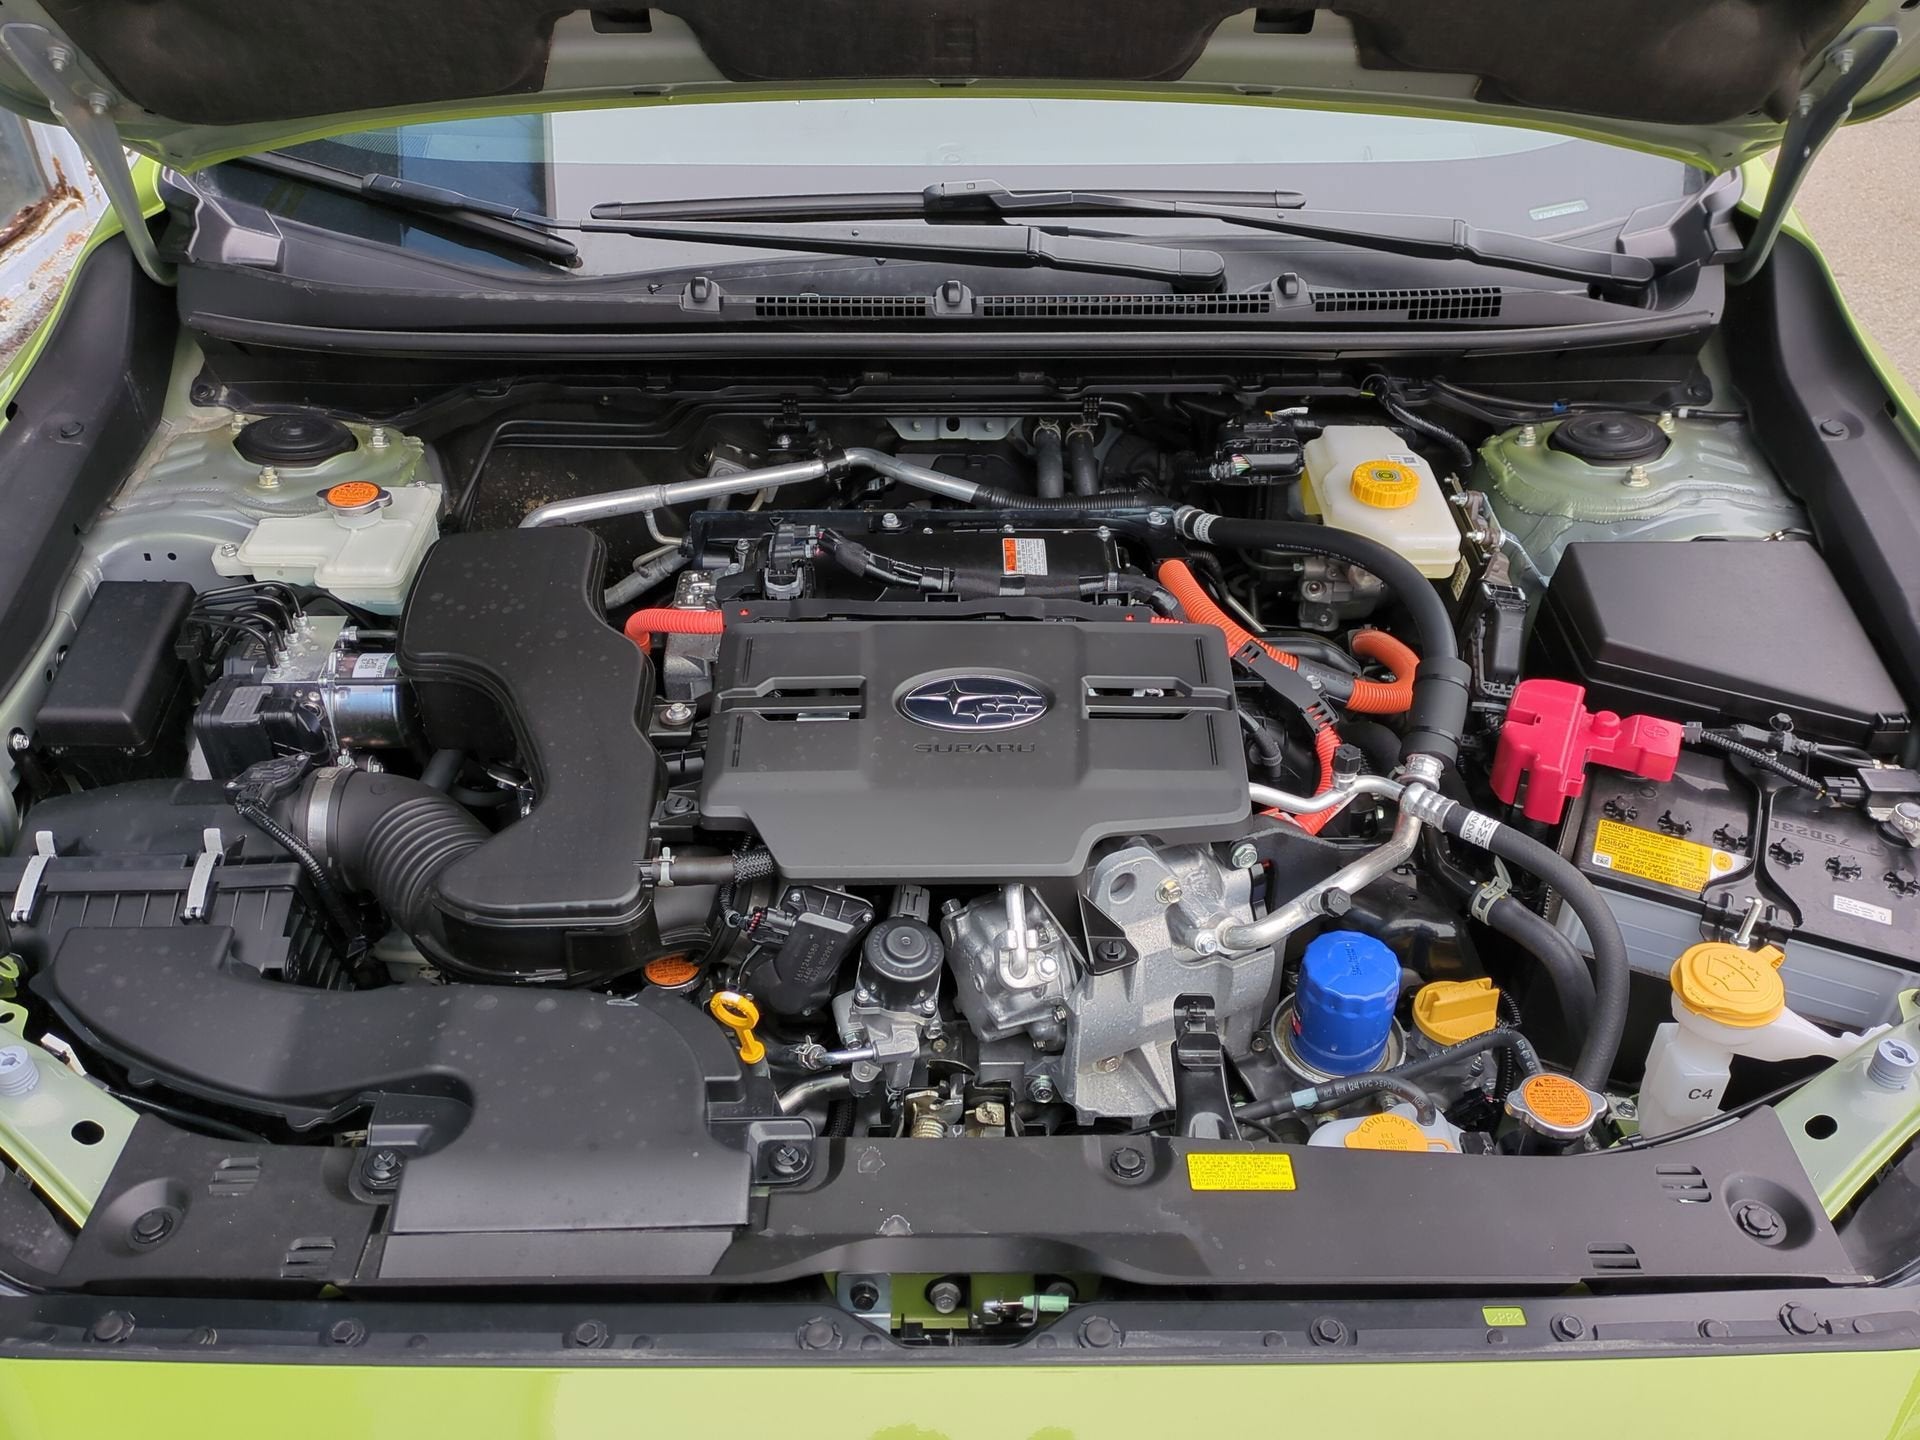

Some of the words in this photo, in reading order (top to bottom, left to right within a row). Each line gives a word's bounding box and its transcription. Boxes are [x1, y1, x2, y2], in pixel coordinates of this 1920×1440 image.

[913, 743, 1036, 753] SUBARU
[1601, 821, 1633, 833] DANGER
[1599, 837, 1630, 850] POISON
[1688, 1088, 1714, 1100] C4
